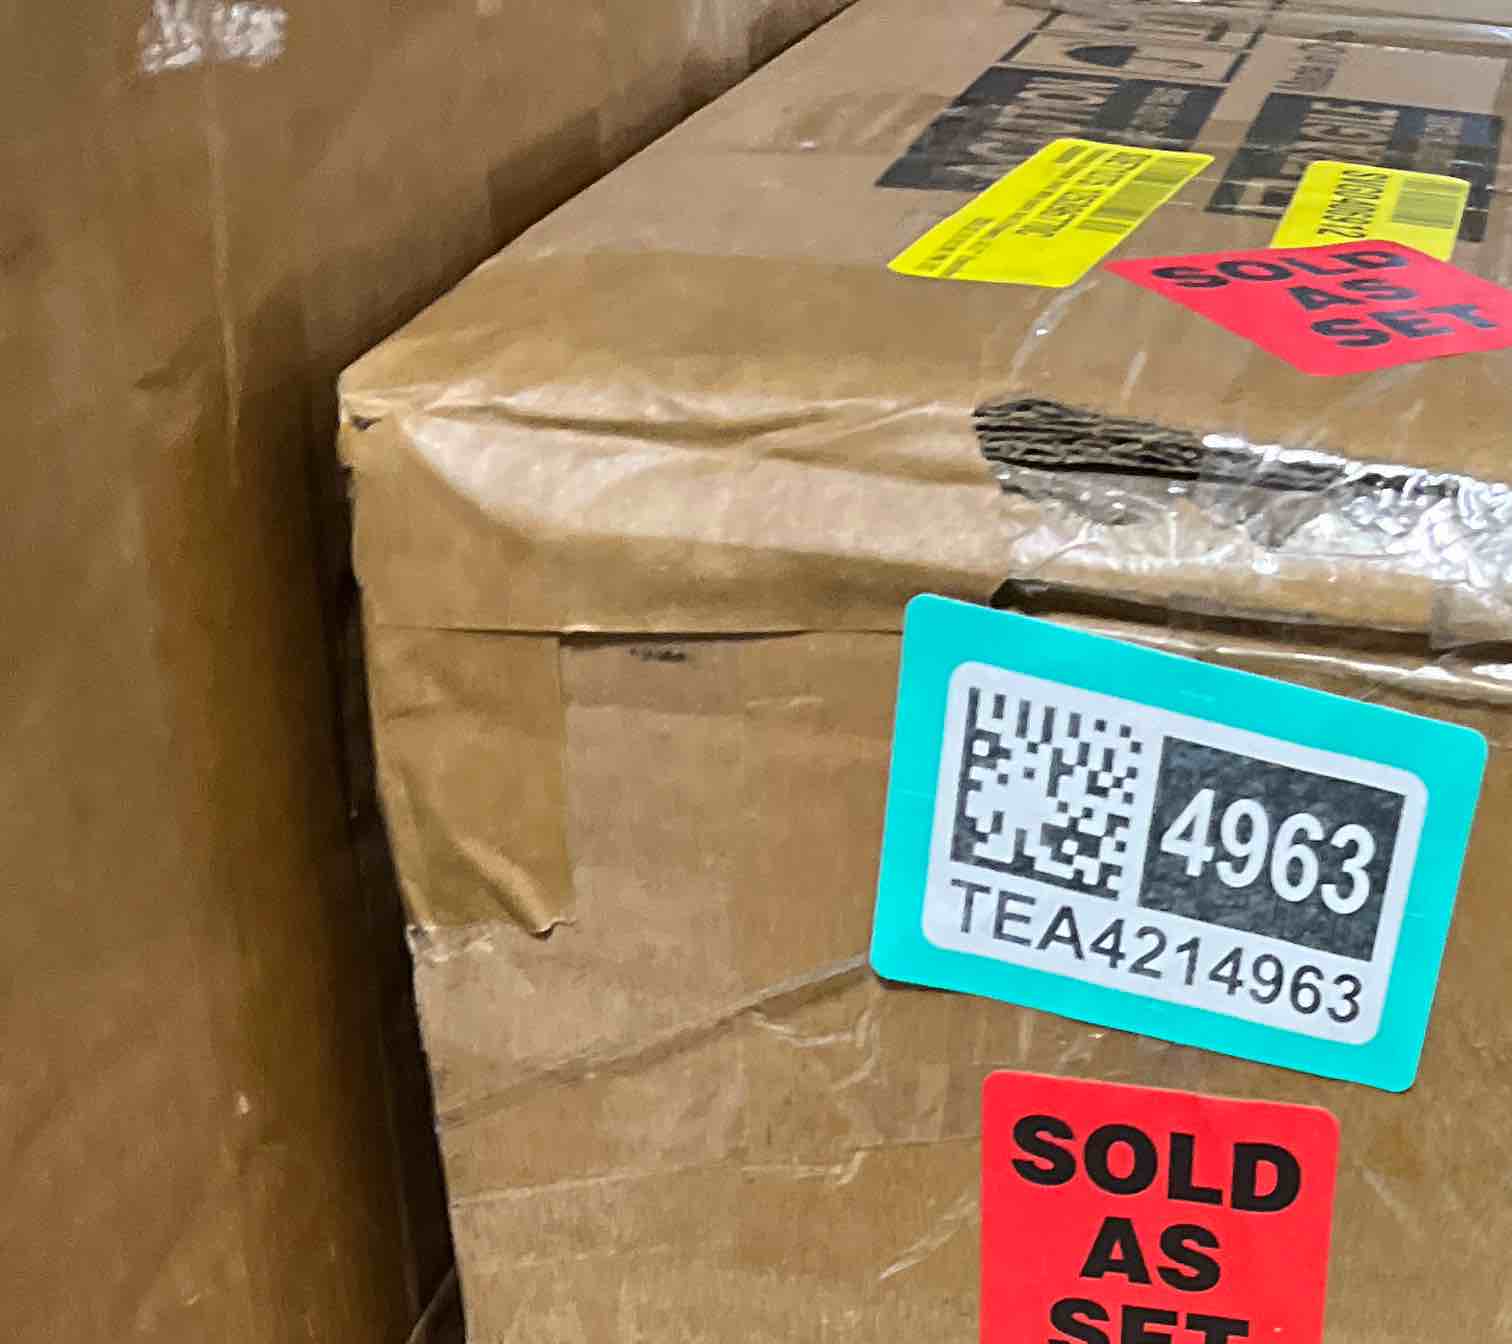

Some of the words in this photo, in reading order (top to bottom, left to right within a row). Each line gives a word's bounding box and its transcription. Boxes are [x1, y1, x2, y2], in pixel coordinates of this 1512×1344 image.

[1151, 250, 1408, 289] SOLD
[1287, 277, 1419, 312] AS
[1311, 303, 1497, 348] SET
[1160, 788, 1376, 915] 4963
[949, 878, 1363, 1024] TEA4214963
[1011, 1114, 1301, 1213] SOLD
[1080, 1216, 1221, 1292] AS
